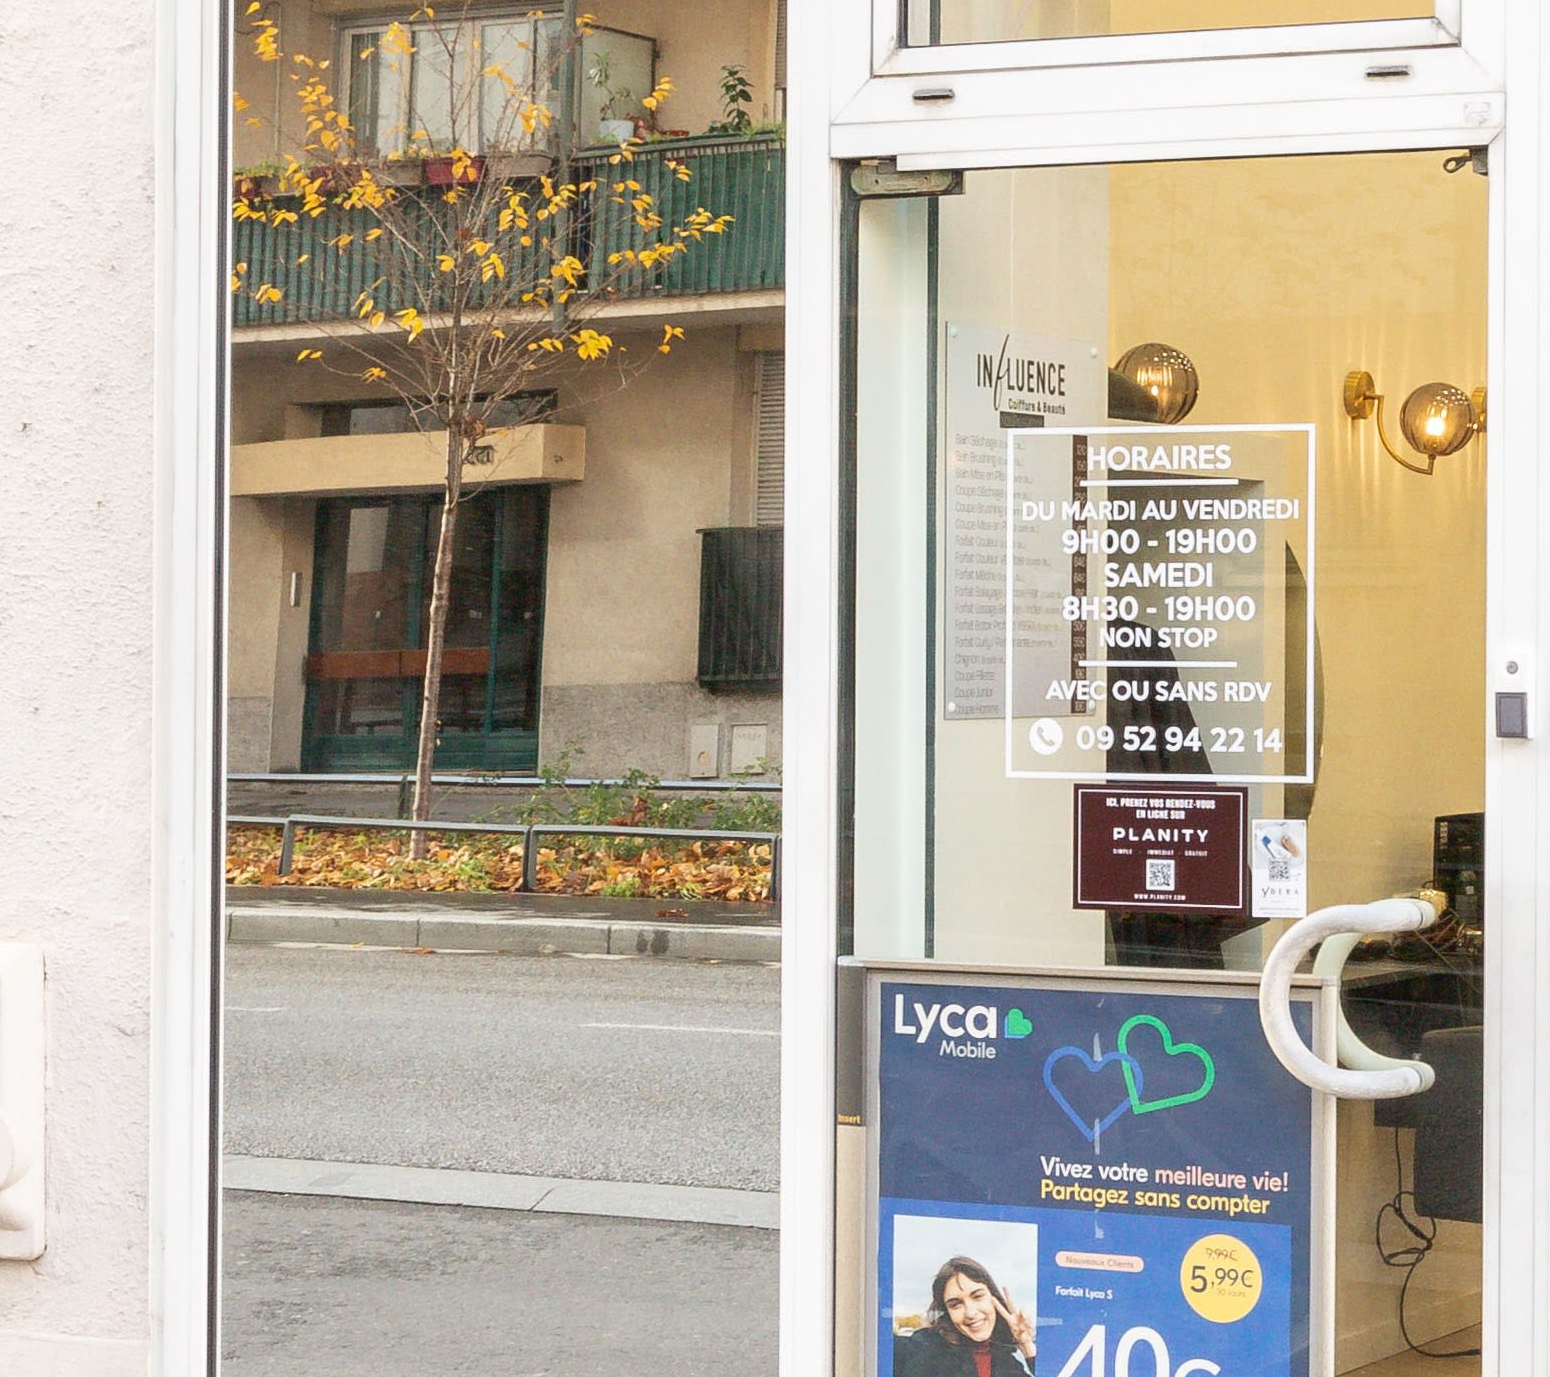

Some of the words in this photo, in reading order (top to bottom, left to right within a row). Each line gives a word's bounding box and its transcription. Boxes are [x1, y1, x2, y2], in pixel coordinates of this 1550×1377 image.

[1008, 398, 1035, 412] Coiffure
[1088, 444, 1232, 470] HORAIRES
[1022, 501, 1055, 521] DU
[1062, 501, 1136, 521] MARDI
[1142, 500, 1177, 520] AU
[1180, 499, 1299, 520] VENDREDI
[1062, 529, 1140, 554] 9H00
[1165, 528, 1257, 553] 19H00
[1104, 563, 1213, 588] SAMEDI
[1062, 596, 1139, 621] 8H30
[1164, 595, 1256, 621] 19H00
[1100, 628, 1152, 648] NON
[1158, 628, 1218, 648] STOP
[1046, 680, 1106, 701] AVEC
[1112, 681, 1149, 701] OU
[1155, 681, 1217, 702] SANS
[1224, 682, 1272, 702] RDV
[1076, 726, 1114, 751] 09
[1123, 726, 1157, 751] 52
[1164, 726, 1202, 752] 94
[1210, 727, 1245, 752] 22
[1253, 727, 1282, 753] 14
[1120, 798, 1148, 808] PRENEZ
[1149, 799, 1164, 808] VOS
[1165, 799, 1216, 810] RENDEZ-VOUS
[1136, 810, 1146, 819] EN
[1146, 810, 1169, 820] LIGNE
[1170, 811, 1185, 820] SUR
[1112, 827, 1209, 843] PLANITY
[894, 993, 997, 1043] Lyca
[939, 1039, 996, 1060] Mobile
[1040, 1156, 1093, 1179] Vivez
[1098, 1162, 1149, 1184] votre
[1155, 1166, 1246, 1190] meilleure
[1252, 1171, 1289, 1192] vie!
[1040, 1179, 1129, 1210] Partagez
[1135, 1190, 1181, 1209] sans
[1187, 1193, 1270, 1218] compter
[1065, 1256, 1104, 1267] Nouveaux
[1107, 1258, 1134, 1269] Clients
[1190, 1265, 1254, 1293] 5,99€
[1055, 1285, 1084, 1297] Forfait
[1085, 1287, 1105, 1299] Lyca
[1106, 1289, 1113, 1299] S
